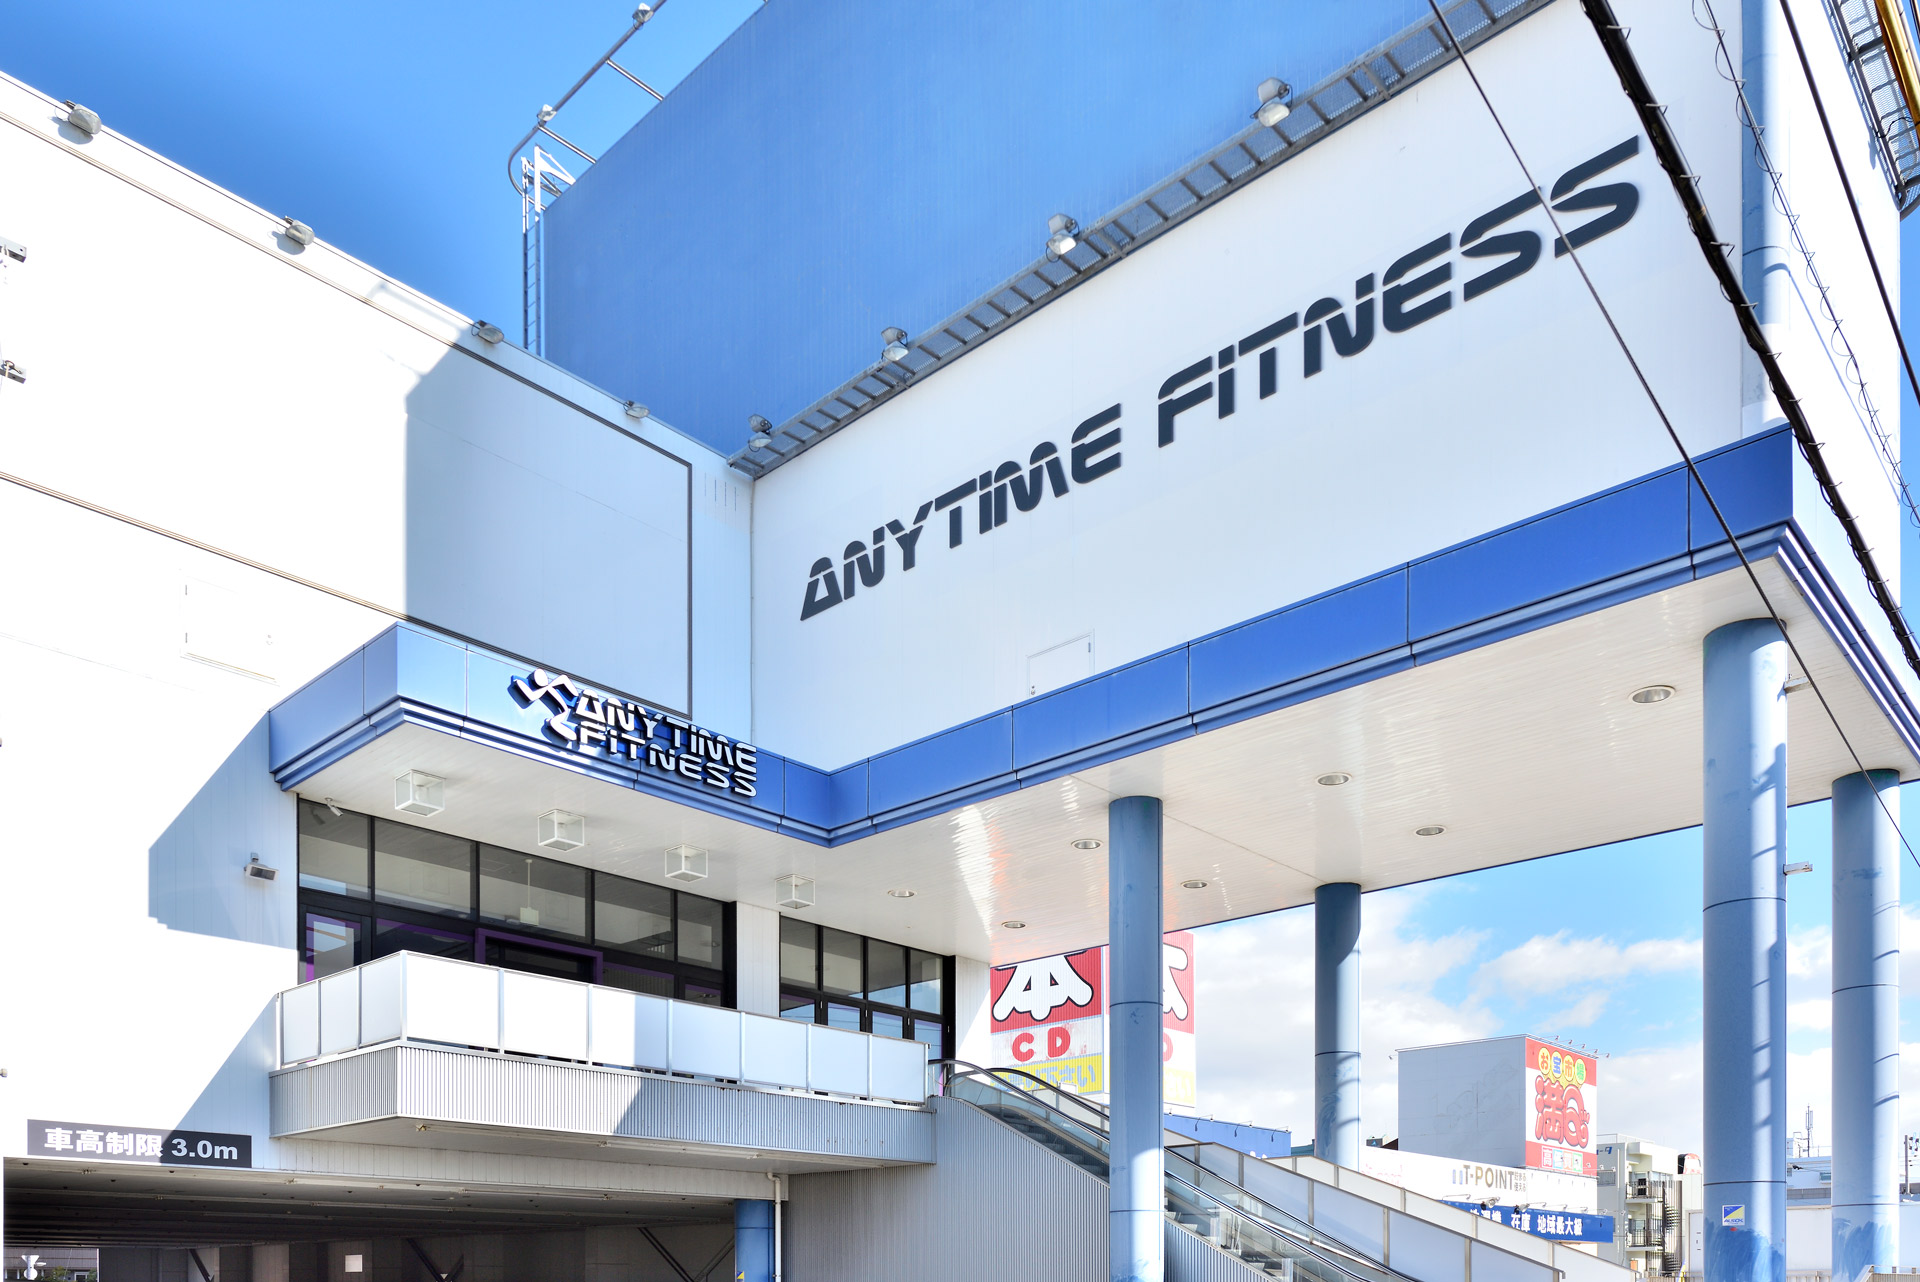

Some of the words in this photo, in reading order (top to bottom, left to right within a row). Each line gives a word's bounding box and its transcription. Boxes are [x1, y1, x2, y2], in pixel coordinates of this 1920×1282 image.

[800, 402, 1122, 621] ANYTIME
[1157, 134, 1641, 448] FITNESS
[575, 688, 757, 774] ANYTIME
[579, 720, 757, 798] FITNESS
[44, 1127, 163, 1158] 車高制限
[171, 1138, 238, 1160] 3.0m
[1463, 1164, 1514, 1190] T-POINT
[1537, 1214, 1583, 1236] 地域最大級
